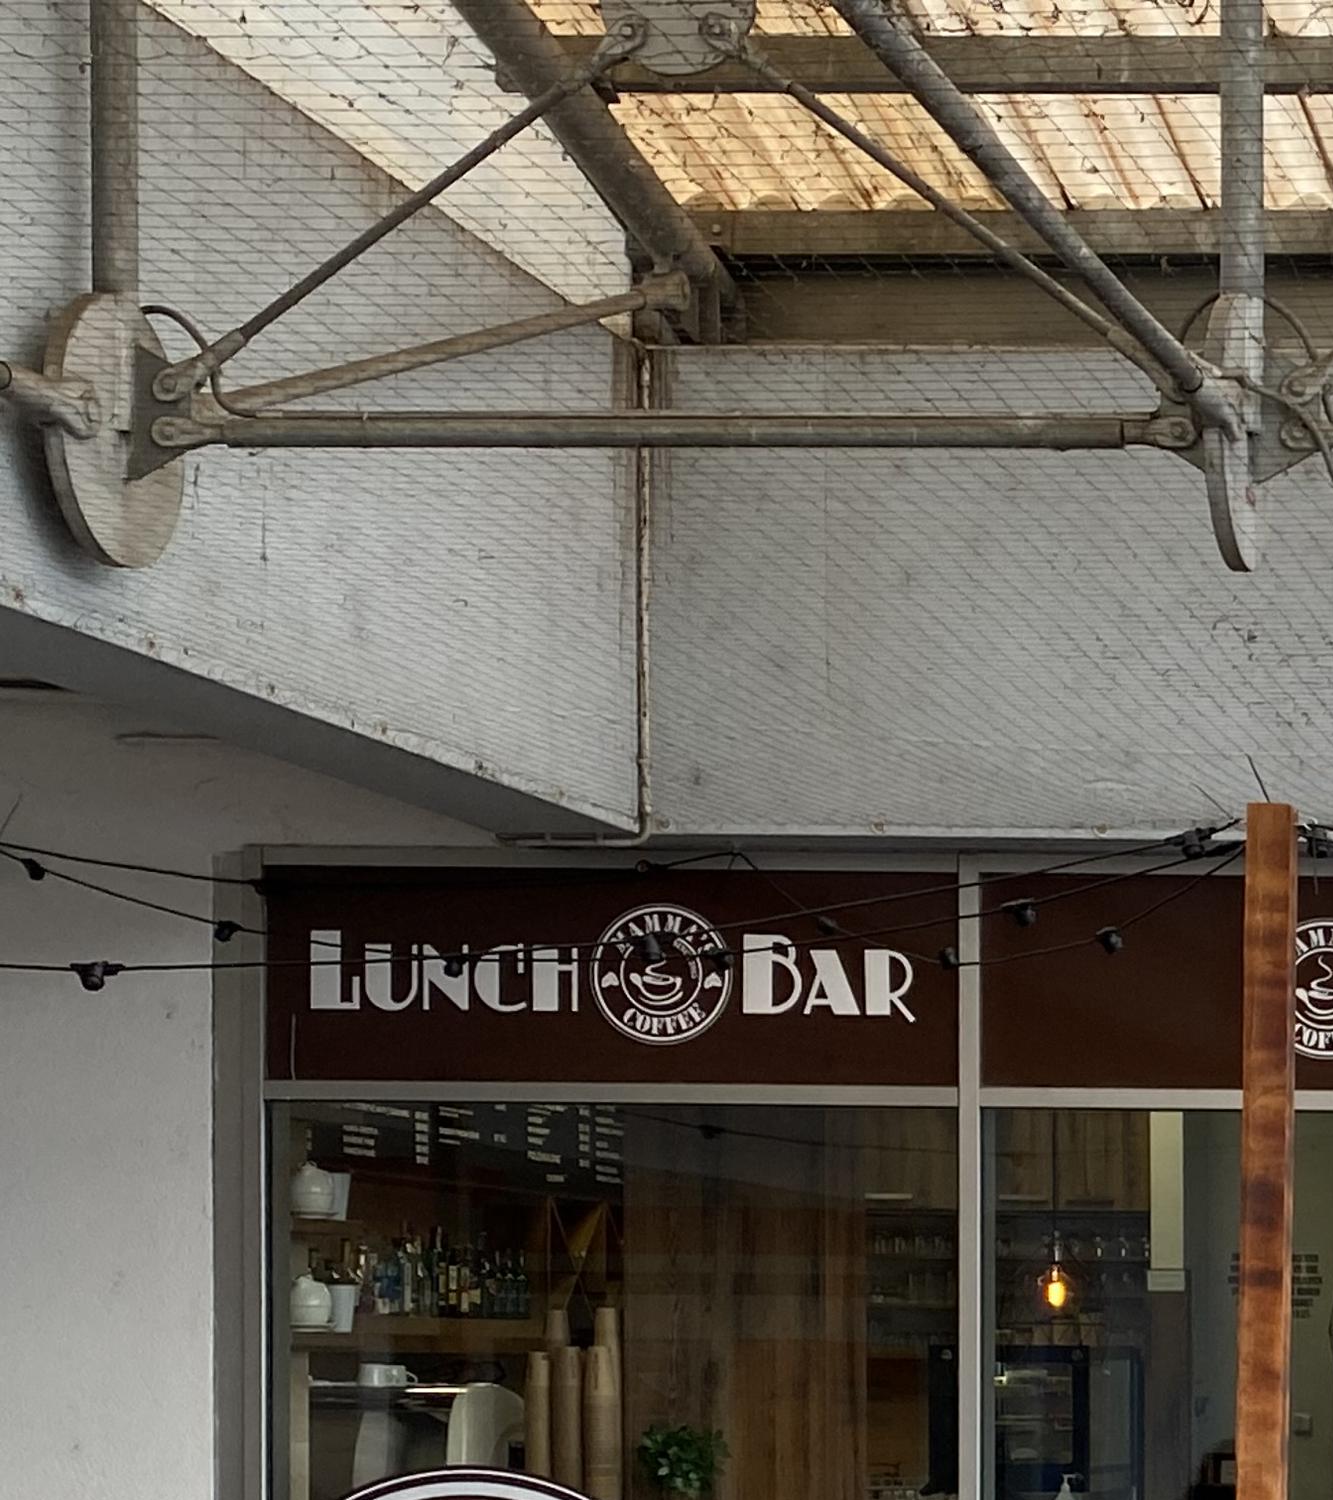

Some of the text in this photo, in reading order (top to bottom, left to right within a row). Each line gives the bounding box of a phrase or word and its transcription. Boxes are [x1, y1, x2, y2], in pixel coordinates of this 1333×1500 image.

[310, 930, 579, 1012] LUNCH
[742, 933, 916, 1023] BAR
[623, 1002, 707, 1035] COFFEE
